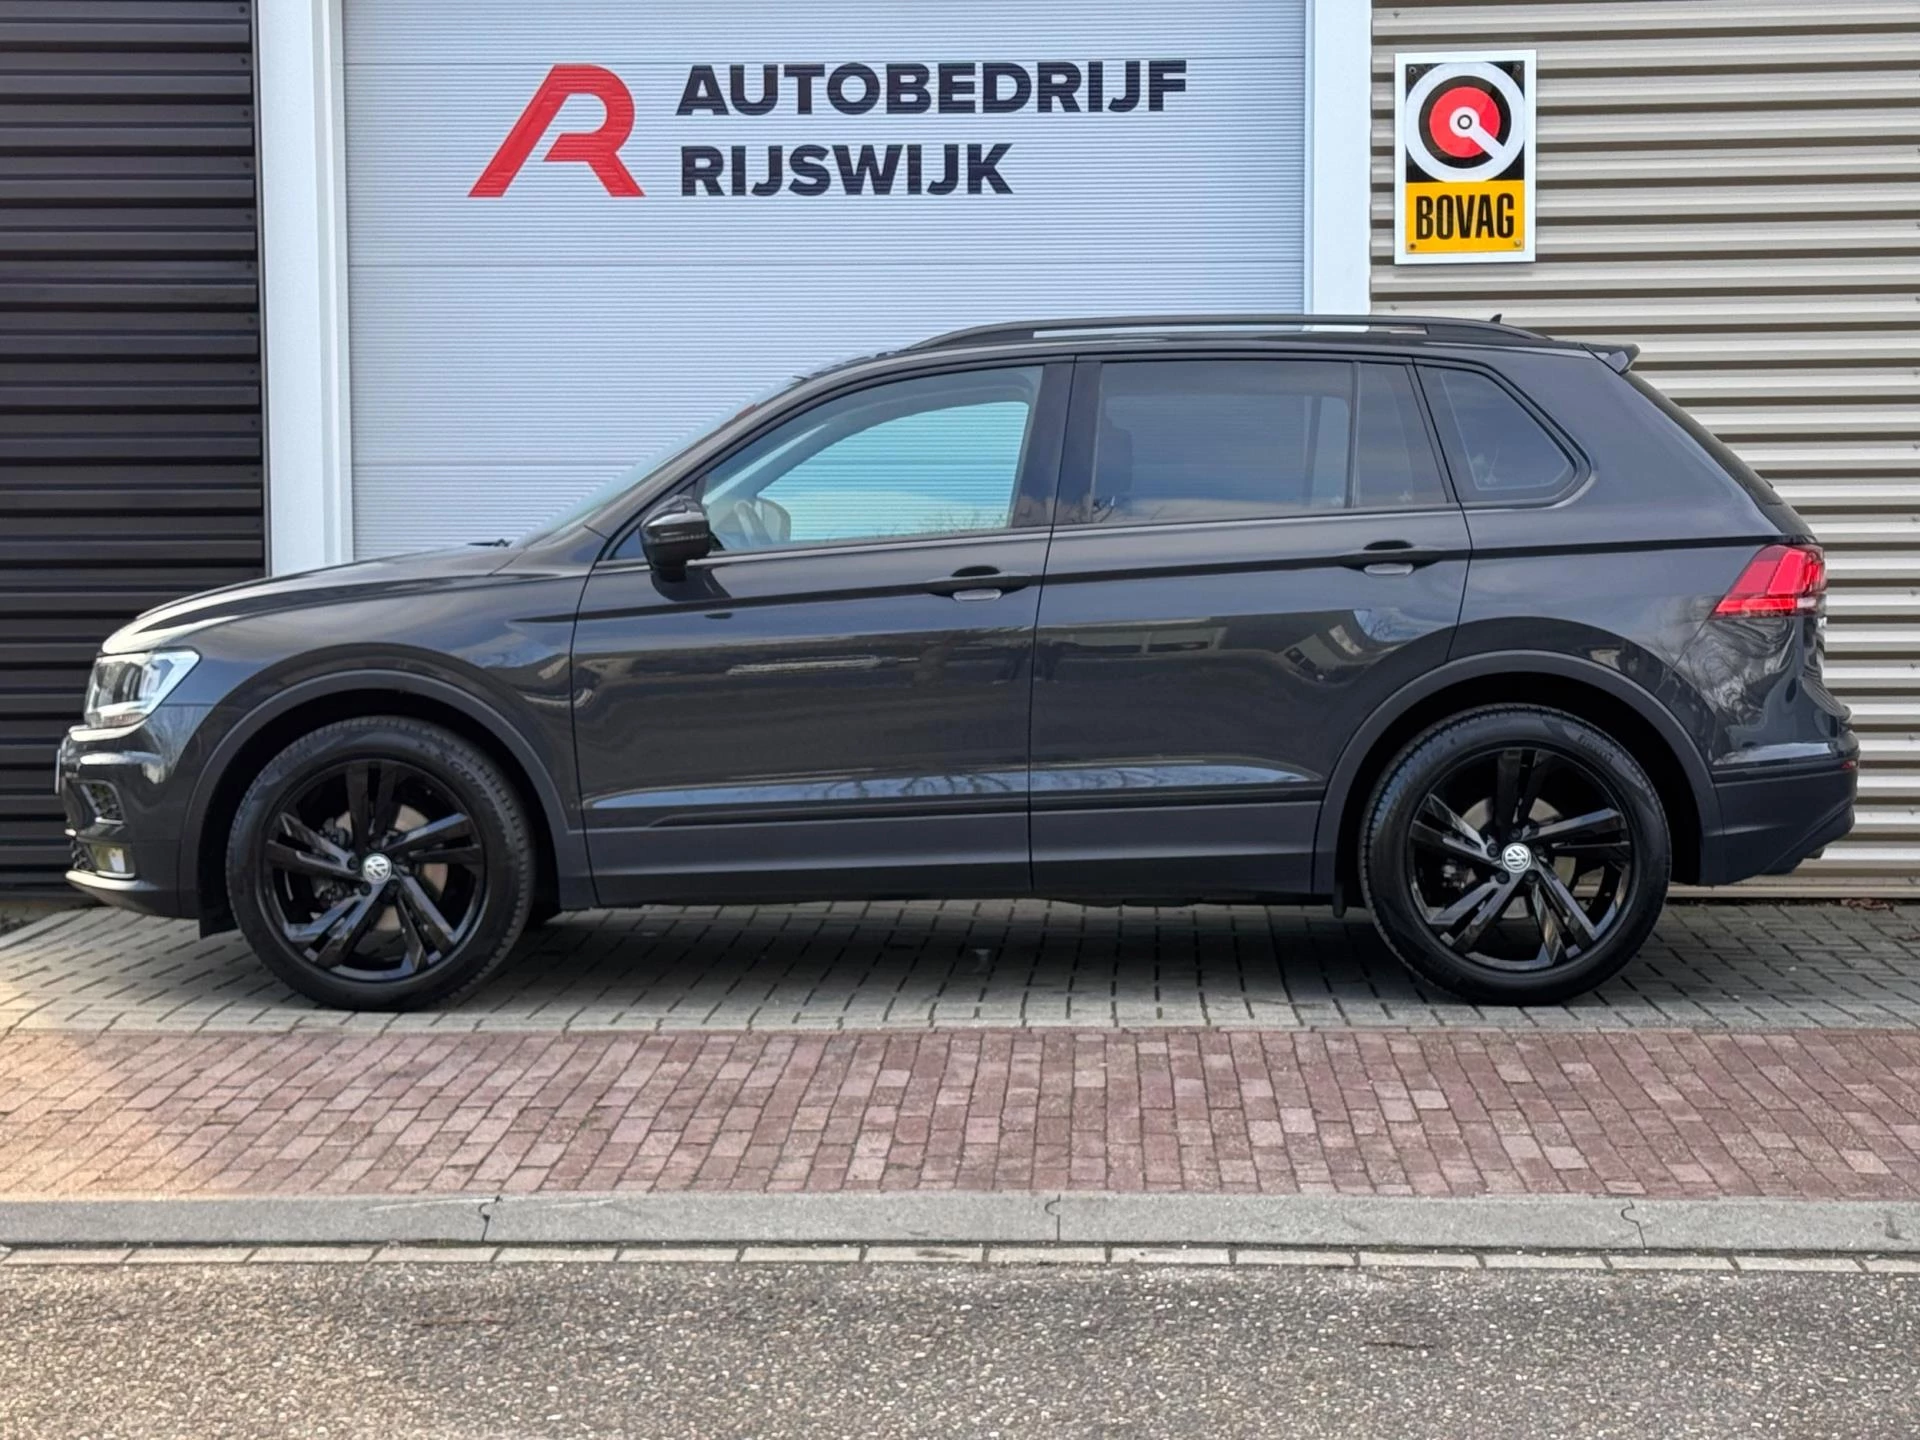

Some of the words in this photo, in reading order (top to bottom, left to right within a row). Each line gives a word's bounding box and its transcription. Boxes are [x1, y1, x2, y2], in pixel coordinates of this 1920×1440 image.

[676, 60, 1187, 116] AUTOBEDRIJF
[680, 144, 1013, 196] RIJSWIJK
[1416, 192, 1515, 240] BOVAG
